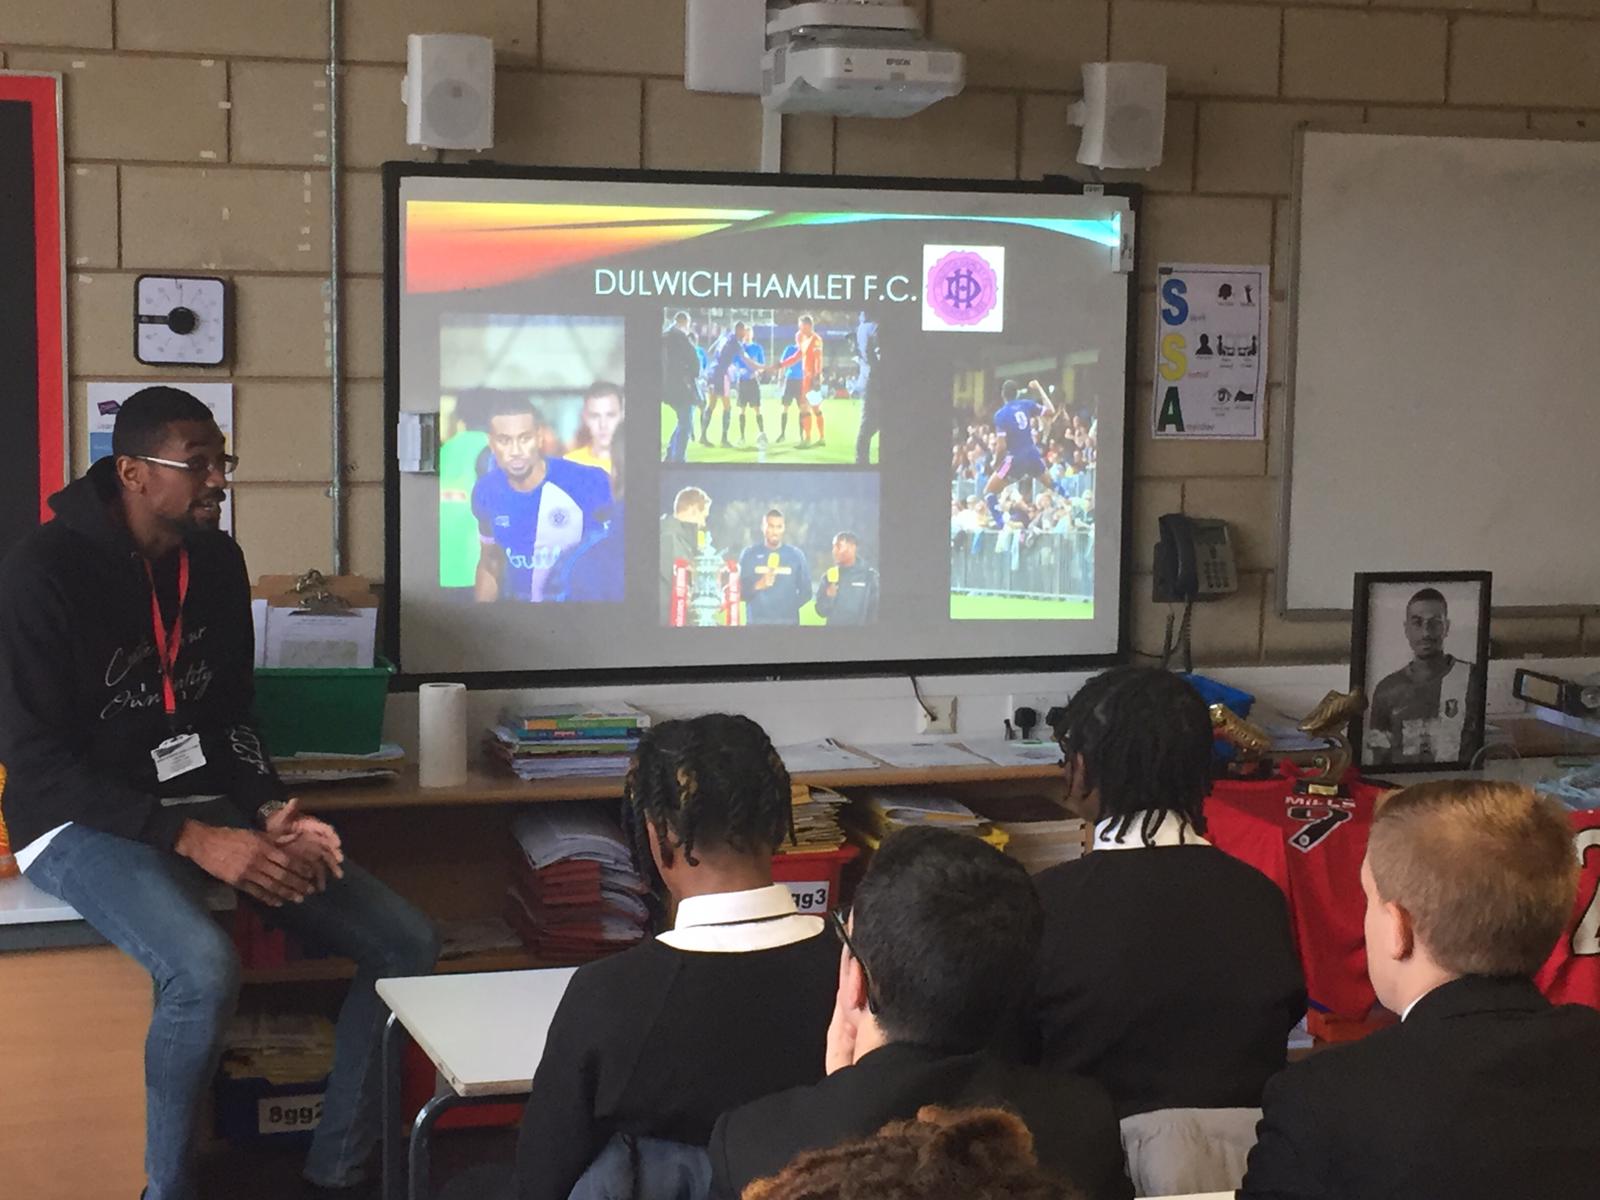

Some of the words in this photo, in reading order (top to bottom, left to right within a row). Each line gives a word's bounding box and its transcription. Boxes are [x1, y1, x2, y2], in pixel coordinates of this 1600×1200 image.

[594, 268, 732, 298] DULWICH
[743, 272, 856, 300] HAMLET
[864, 275, 917, 302] F.C.
[1162, 278, 1189, 326] S
[1159, 332, 1188, 382] S
[1157, 386, 1186, 432] A
[1285, 796, 1356, 808] MILLS
